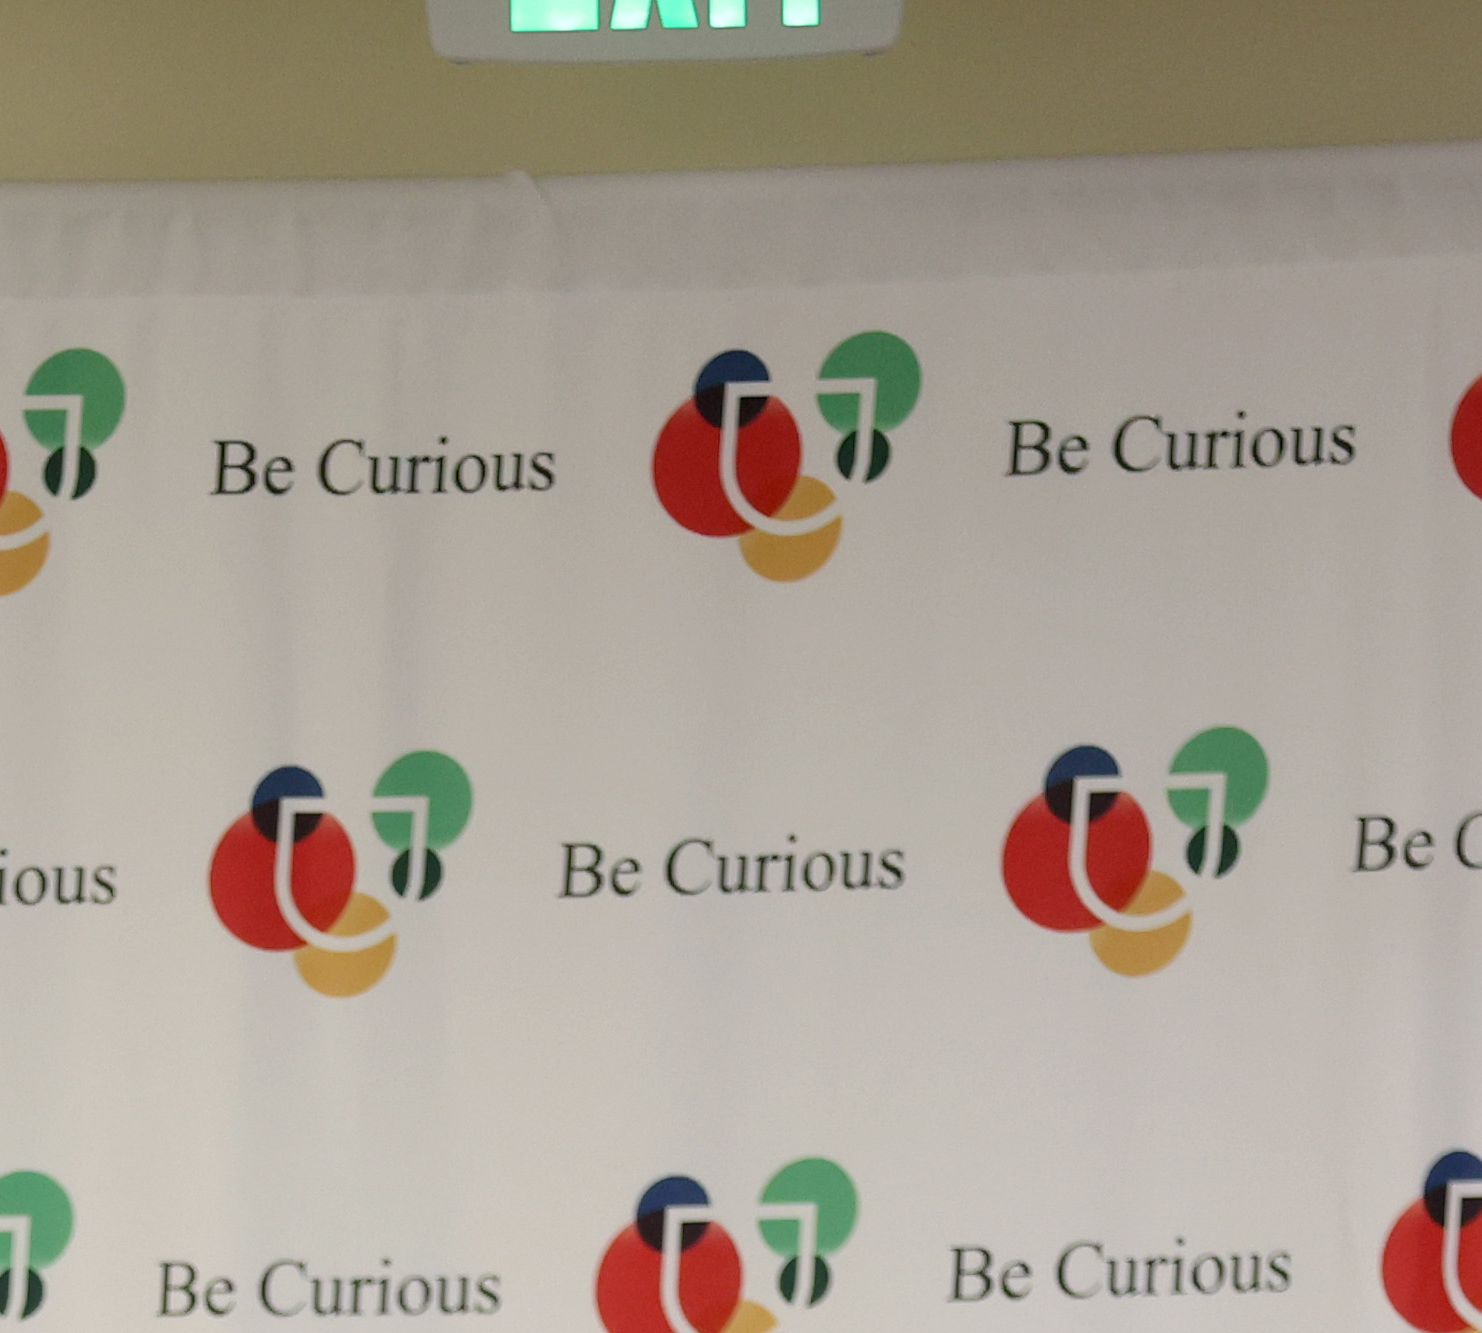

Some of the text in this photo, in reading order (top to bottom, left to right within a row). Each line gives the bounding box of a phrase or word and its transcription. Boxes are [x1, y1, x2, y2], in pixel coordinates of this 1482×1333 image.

[208, 434, 557, 498] Be Curious
[1003, 409, 1358, 478] Be Curious
[556, 833, 907, 900] Be Curious
[1351, 813, 1437, 874] Be
[155, 1256, 502, 1319] Be Curious
[947, 1236, 1293, 1304] Be Curious
